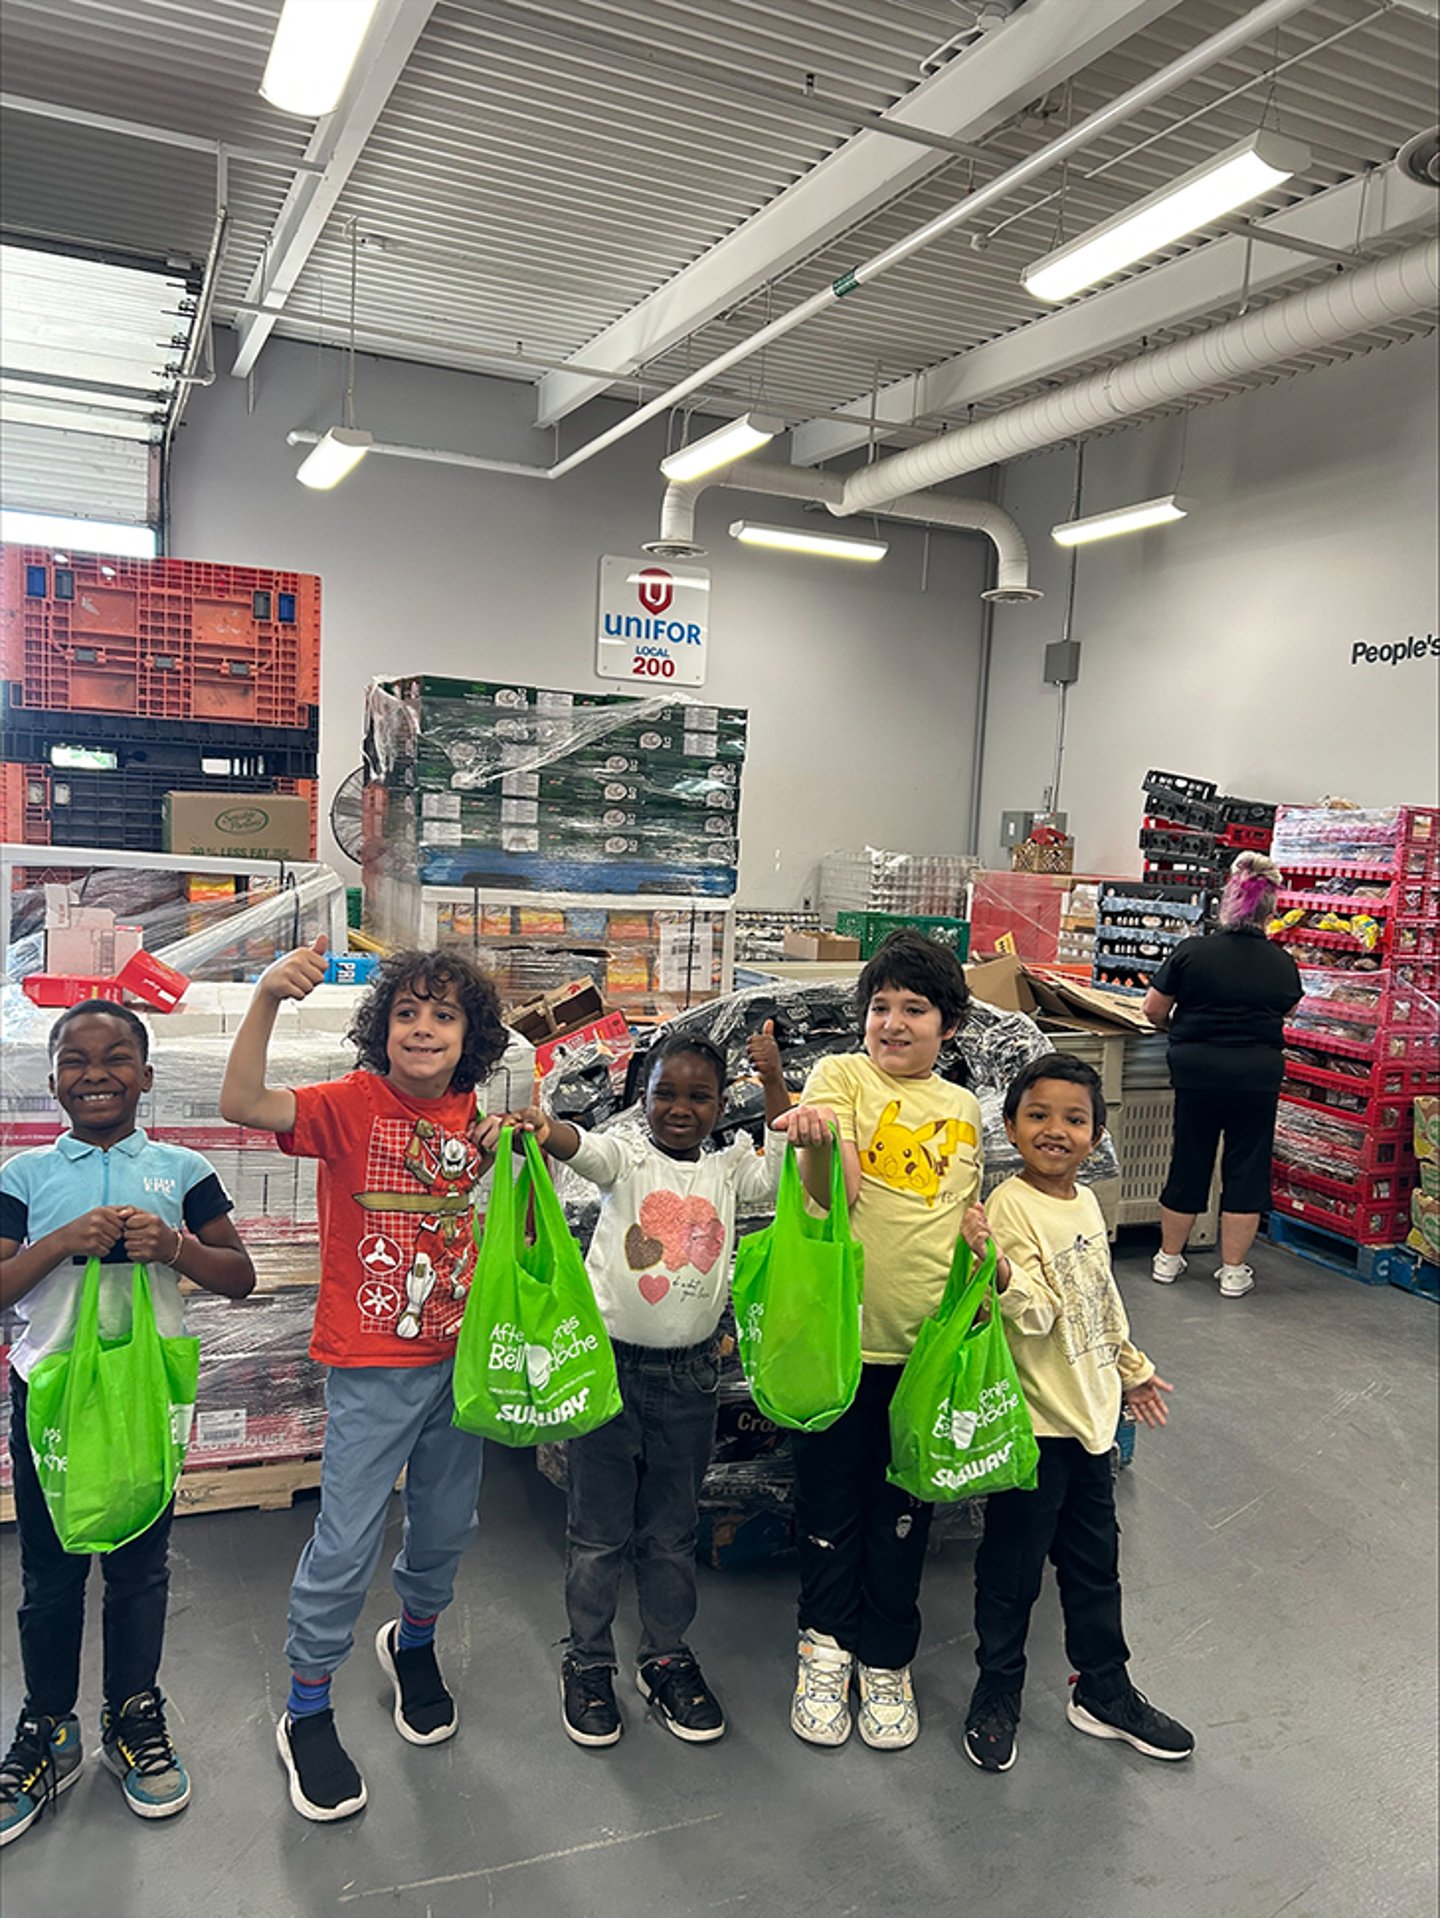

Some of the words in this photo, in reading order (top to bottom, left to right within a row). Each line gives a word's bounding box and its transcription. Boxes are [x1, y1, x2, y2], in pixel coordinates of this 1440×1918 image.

[604, 613, 702, 646] UNIFOR
[636, 646, 670, 658] LOCAL
[1351, 634, 1440, 666] People's
[632, 656, 675, 678] 200
[489, 1321, 525, 1343] Afte
